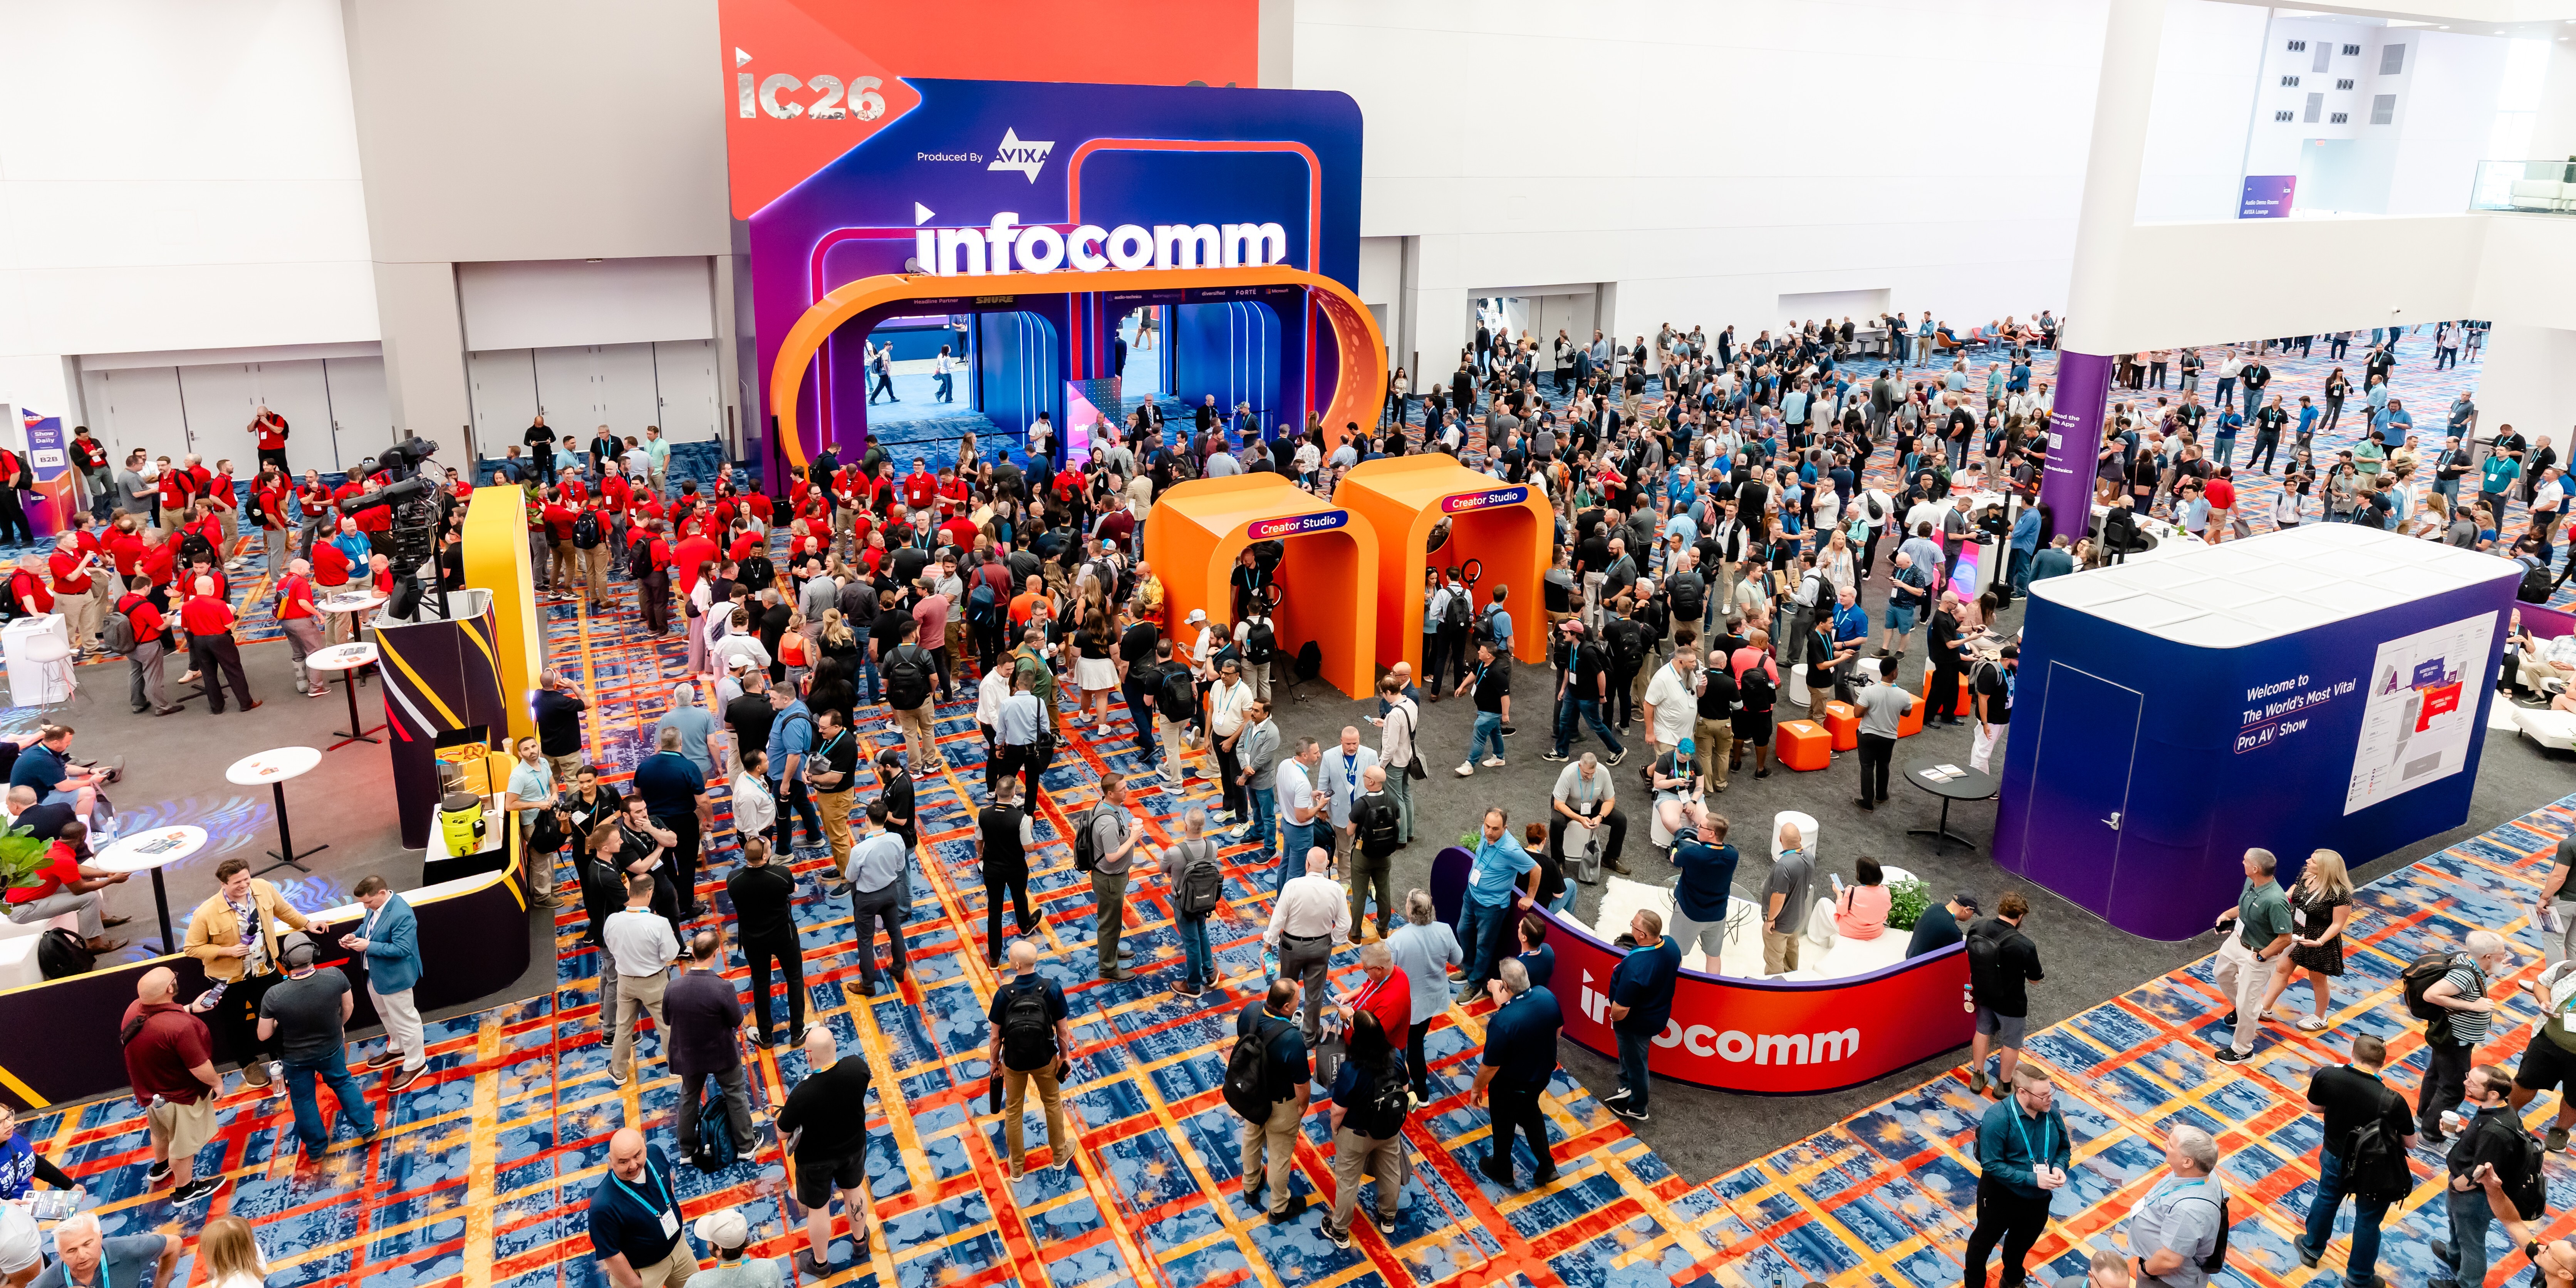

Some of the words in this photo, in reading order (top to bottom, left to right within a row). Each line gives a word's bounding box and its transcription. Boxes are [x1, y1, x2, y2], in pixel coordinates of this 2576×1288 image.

[735, 47, 886, 121] ic26
[917, 152, 967, 161] Produced
[970, 153, 983, 163] By
[993, 148, 1049, 163] AVIXA
[915, 201, 1286, 276] infocomm
[976, 295, 1013, 304] SHURE
[1452, 495, 1487, 508] Creator
[1489, 491, 1518, 503] Studio
[1260, 520, 1301, 535] Creator
[1303, 515, 1337, 528] Studio
[2247, 679, 2295, 701] Welcome
[2298, 674, 2309, 687] to
[2243, 709, 2262, 724] The
[2266, 695, 2304, 717] World’s
[2306, 687, 2331, 704] Most
[2334, 678, 2356, 696] Vital
[2237, 736, 2256, 750] Pro
[2258, 726, 2275, 743] AV
[2279, 719, 2308, 736] Show
[1581, 968, 1860, 1067] inocomm
[0, 1161, 11, 1172] GET
